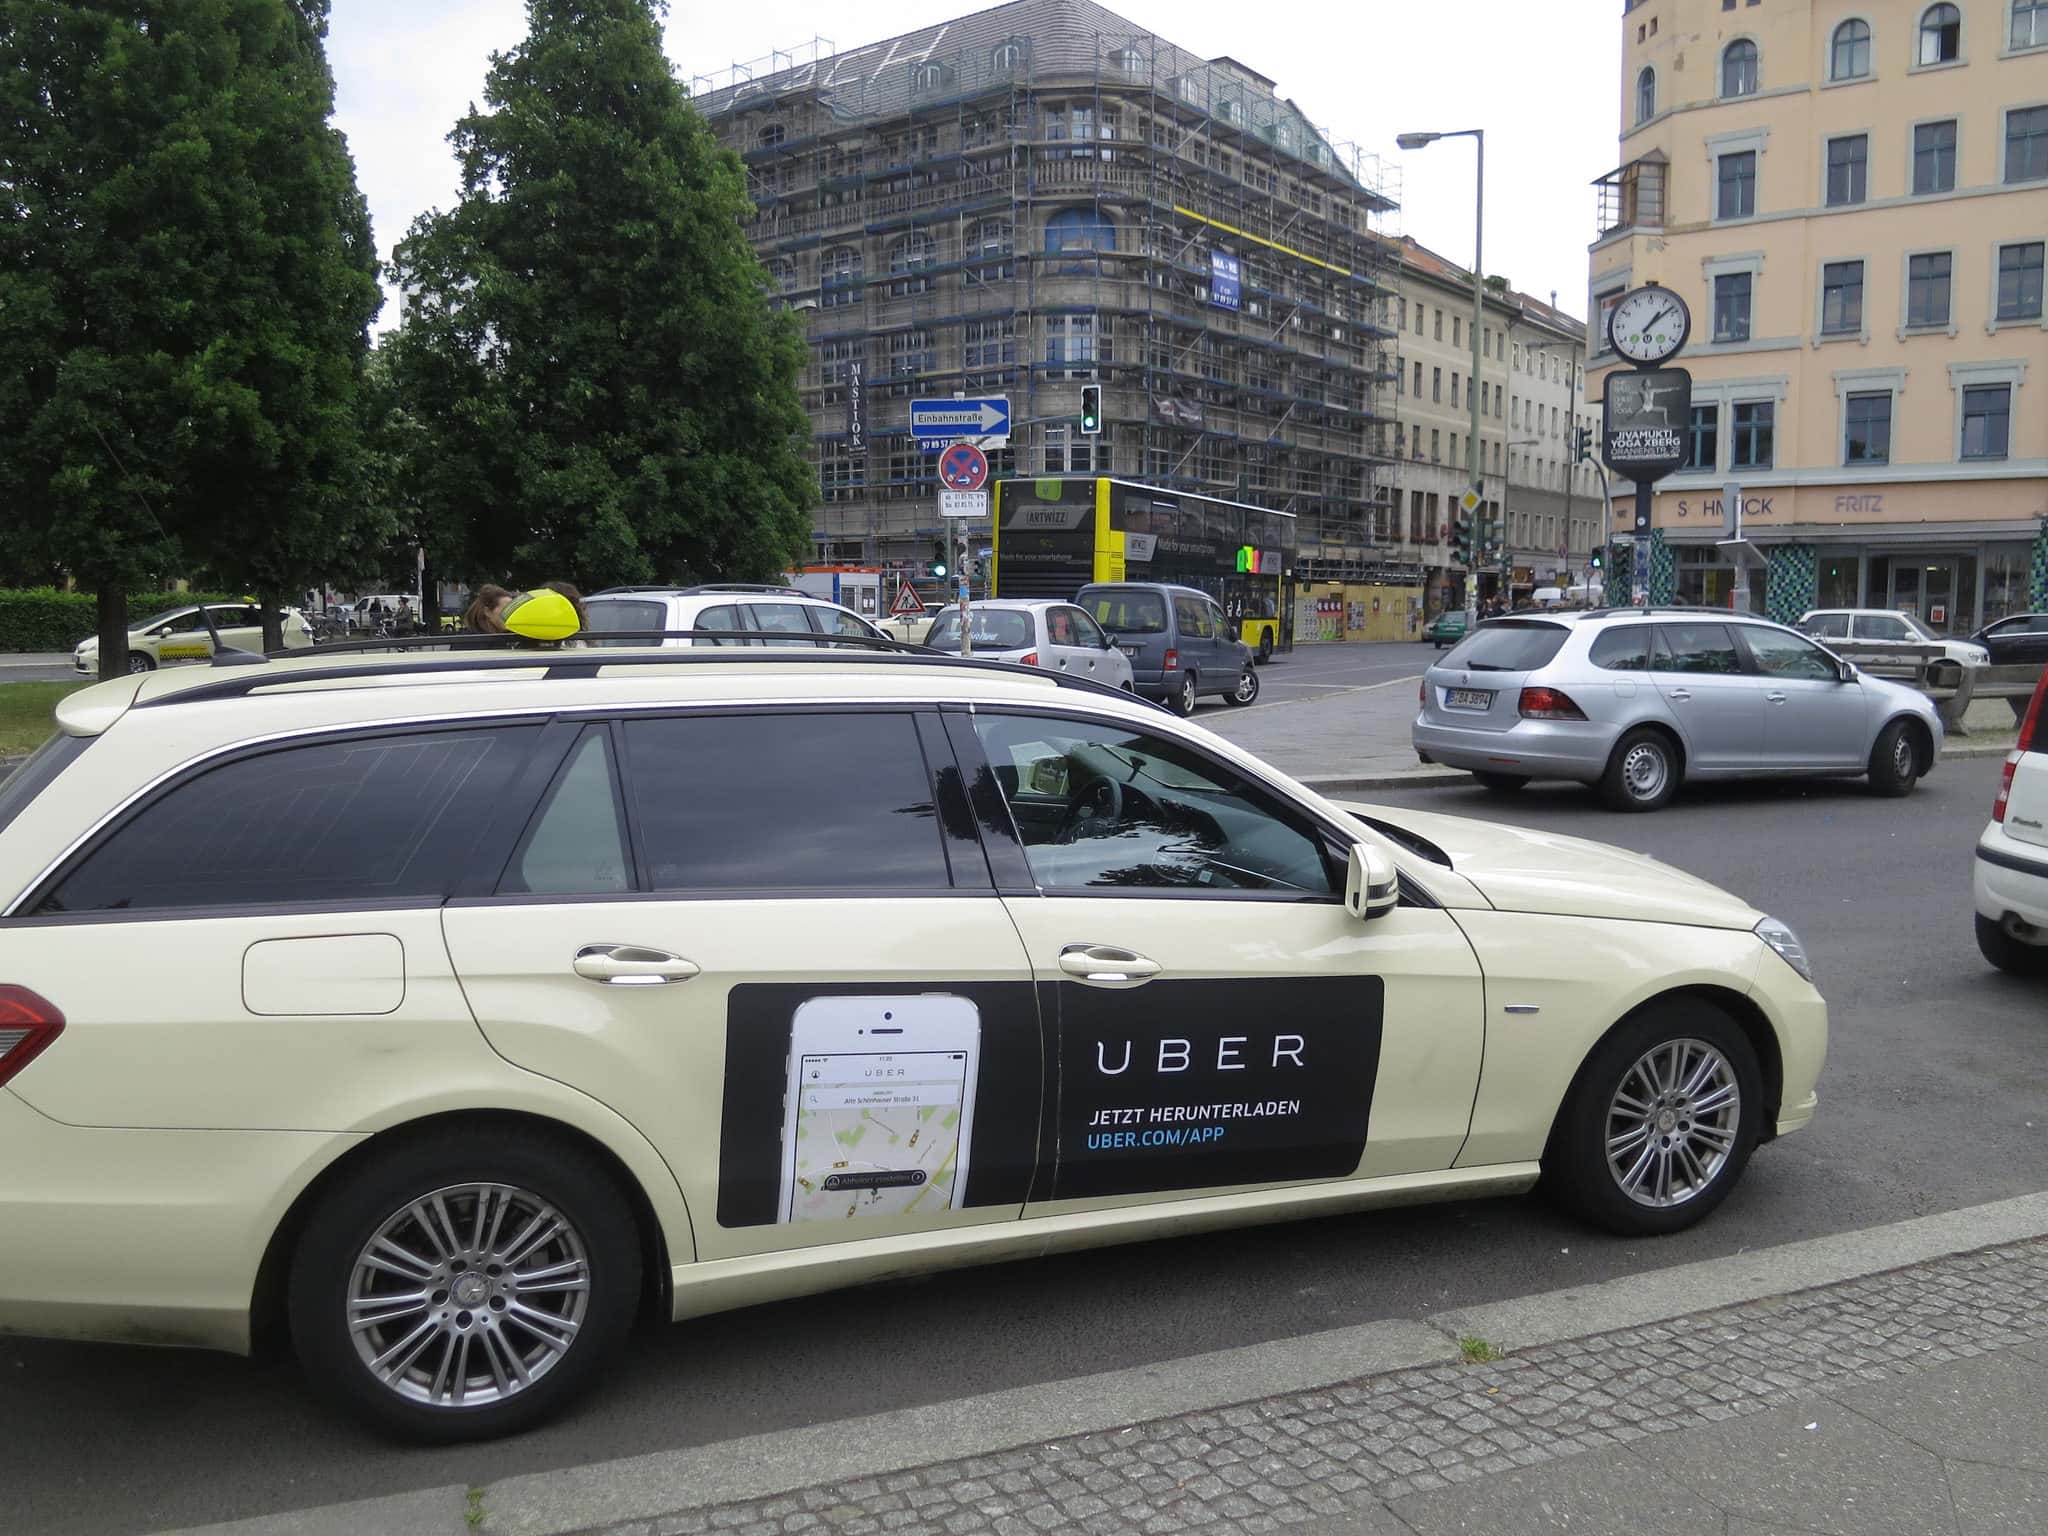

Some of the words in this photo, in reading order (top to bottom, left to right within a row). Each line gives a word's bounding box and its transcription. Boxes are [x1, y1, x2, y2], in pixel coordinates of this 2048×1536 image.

[851, 363, 862, 445] MASTIOK
[918, 413, 983, 423] Einbahnstraße
[1611, 439, 1641, 448] YOGA
[1644, 437, 1681, 447] XBERG
[1616, 429, 1673, 440] JIVAMUKTI
[1835, 495, 1883, 512] FRITZ
[1097, 1034, 1305, 1075] UBER
[864, 1068, 905, 1077] UBER
[1089, 1108, 1144, 1126] JETZT
[1149, 1099, 1301, 1123] HERUNTERLADEN
[1087, 1126, 1225, 1150] UBER.COM/APP
